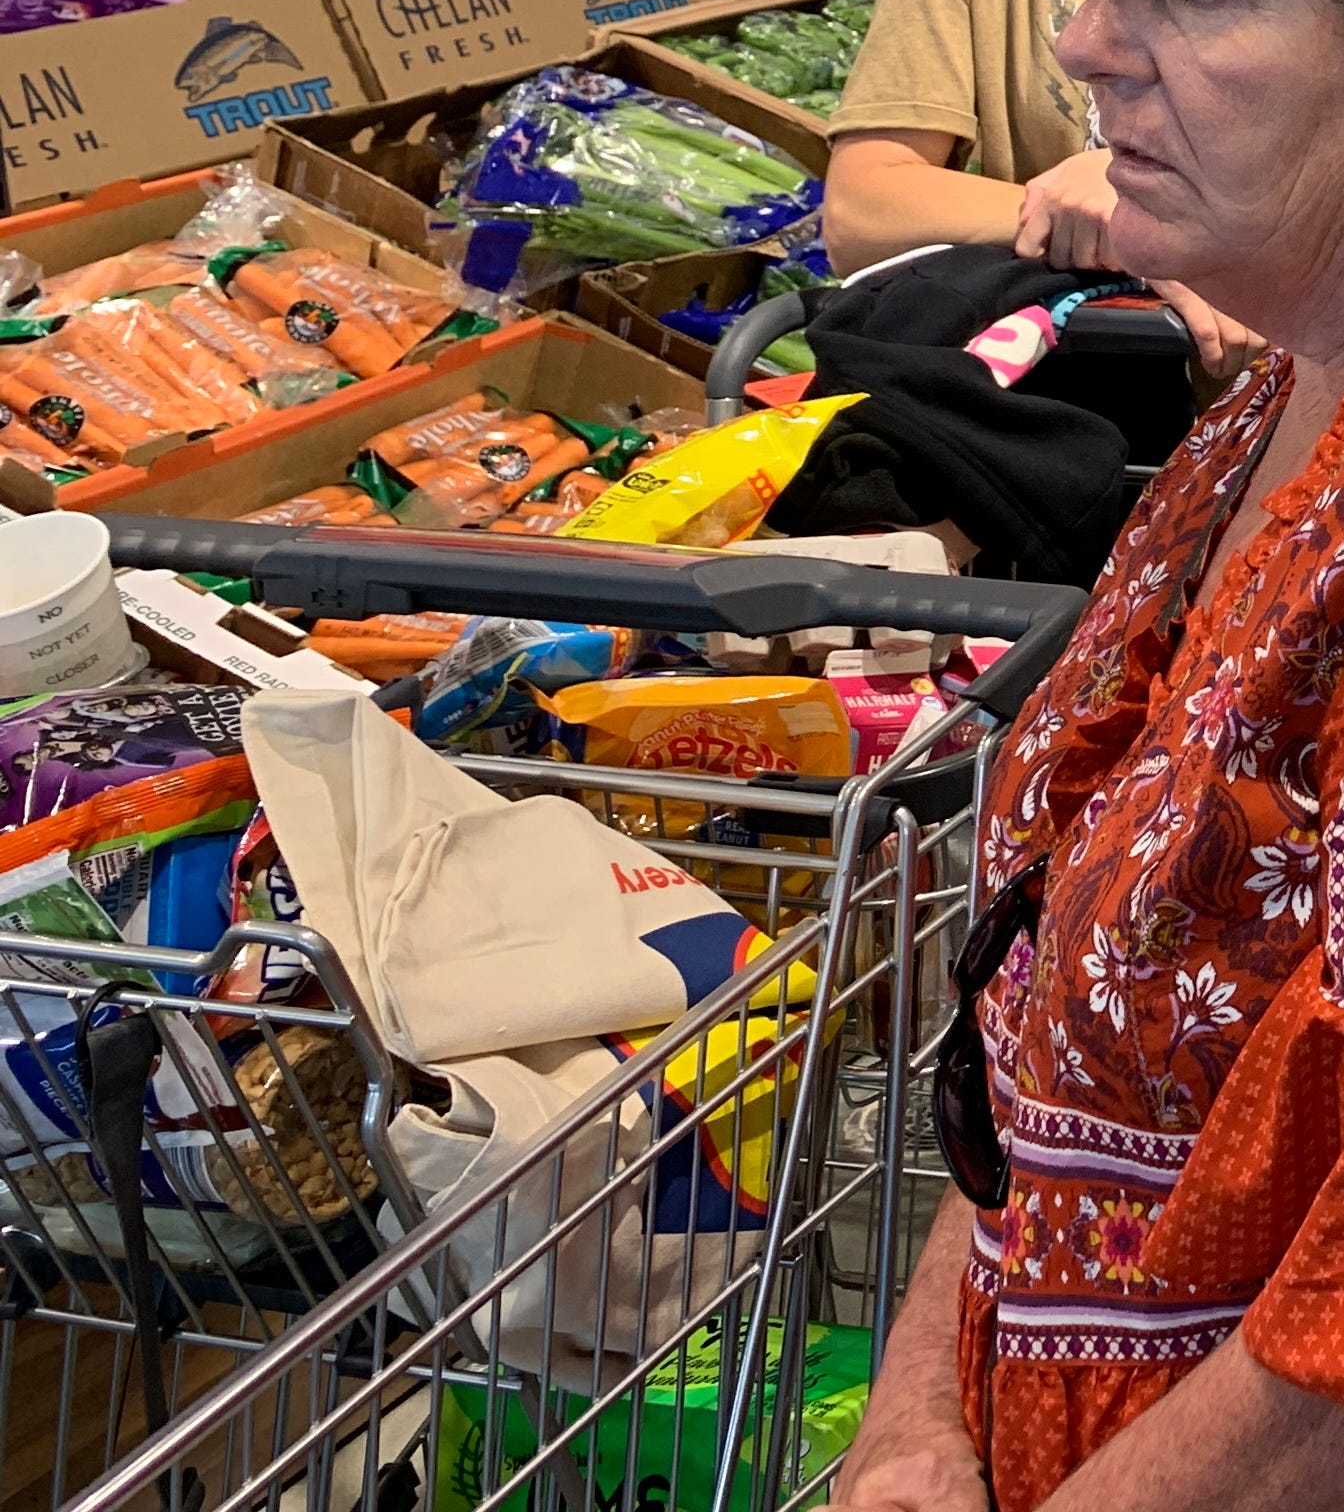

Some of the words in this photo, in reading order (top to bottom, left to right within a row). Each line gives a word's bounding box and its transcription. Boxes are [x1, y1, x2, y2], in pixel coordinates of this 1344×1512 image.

[398, 27, 524, 71] FRESH
[0, 65, 85, 130] LAN
[184, 76, 333, 138] TROUT
[5, 129, 100, 169] ESH
[38, 605, 63, 625] NO
[117, 590, 196, 642] RE-COOLED
[28, 641, 62, 661] NOT
[65, 622, 92, 647] YET
[46, 653, 100, 686] CLOSER
[223, 655, 257, 675] RED
[256, 671, 294, 690] RAD
[178, 693, 205, 706] A
[211, 691, 243, 742] OVIE
[185, 710, 226, 743] GET
[716, 831, 750, 845] EANUT
